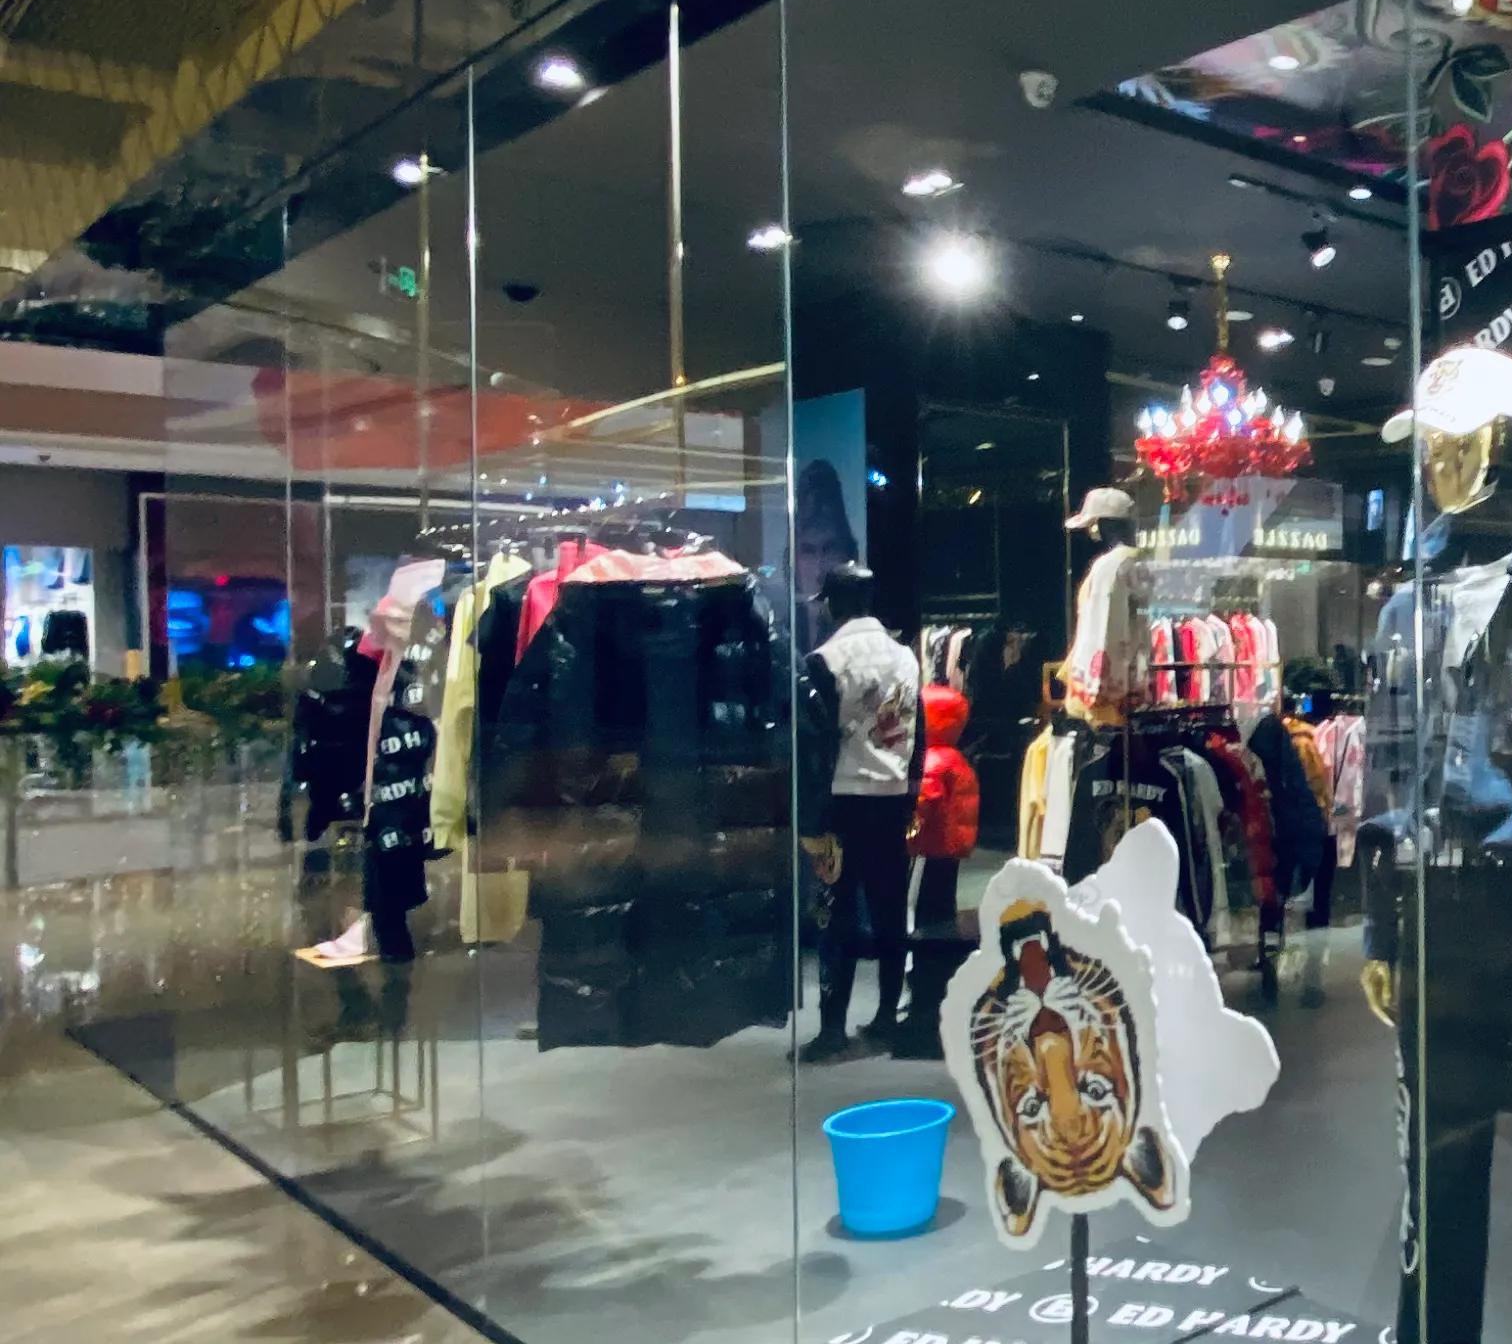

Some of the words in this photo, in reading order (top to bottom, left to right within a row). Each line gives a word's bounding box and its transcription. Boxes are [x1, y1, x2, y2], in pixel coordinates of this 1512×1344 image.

[1465, 248, 1497, 287] ED
[1086, 1256, 1229, 1286] HARDY
[1107, 1303, 1174, 1329] ED
[1177, 1310, 1357, 1344] HARDY
